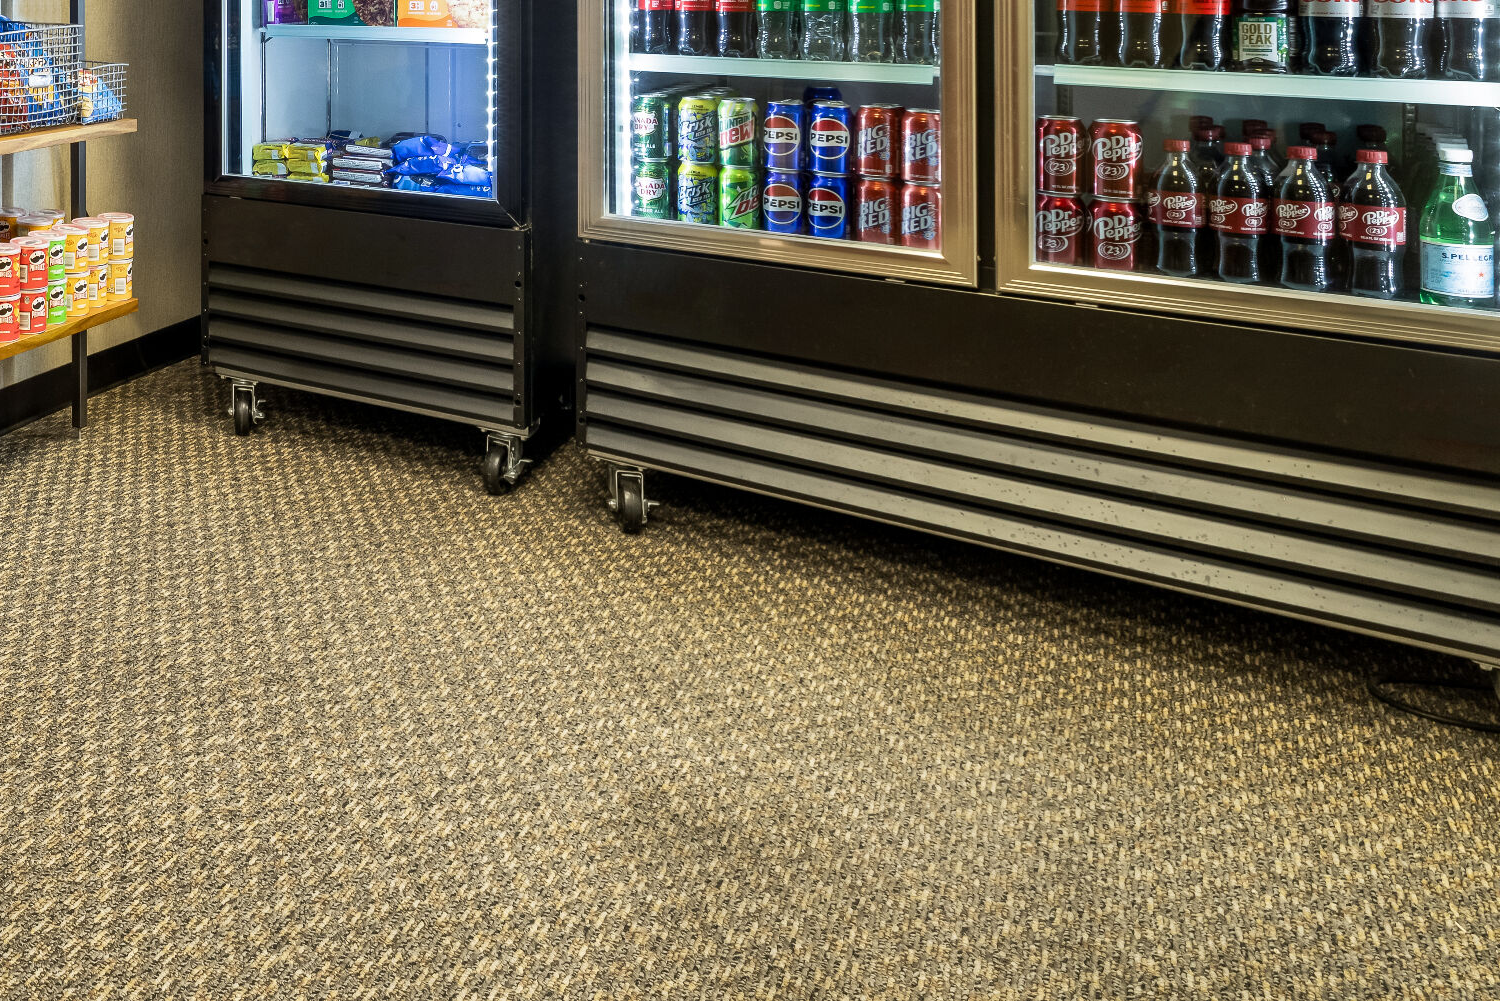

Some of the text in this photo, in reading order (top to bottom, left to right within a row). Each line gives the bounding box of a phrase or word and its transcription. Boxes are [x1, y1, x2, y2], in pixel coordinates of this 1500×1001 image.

[1241, 24, 1272, 34] GOLD
[1242, 34, 1272, 44] PEAK
[764, 130, 797, 141] PEPSI
[811, 133, 848, 144] PEPSI
[858, 125, 883, 142] BIG
[907, 130, 934, 145] BIG
[858, 136, 888, 157] RED
[1111, 136, 1132, 147] Dr
[906, 142, 938, 161] RED
[1097, 138, 1142, 161] Pepper
[1105, 166, 1116, 175] 23
[764, 198, 800, 209] PEPSI
[808, 202, 842, 214] PEPSI
[861, 198, 886, 214] BIG
[859, 210, 890, 229] RED
[1038, 211, 1082, 234] Pepper
[1442, 252, 1493, 262] S.PELLEGR
